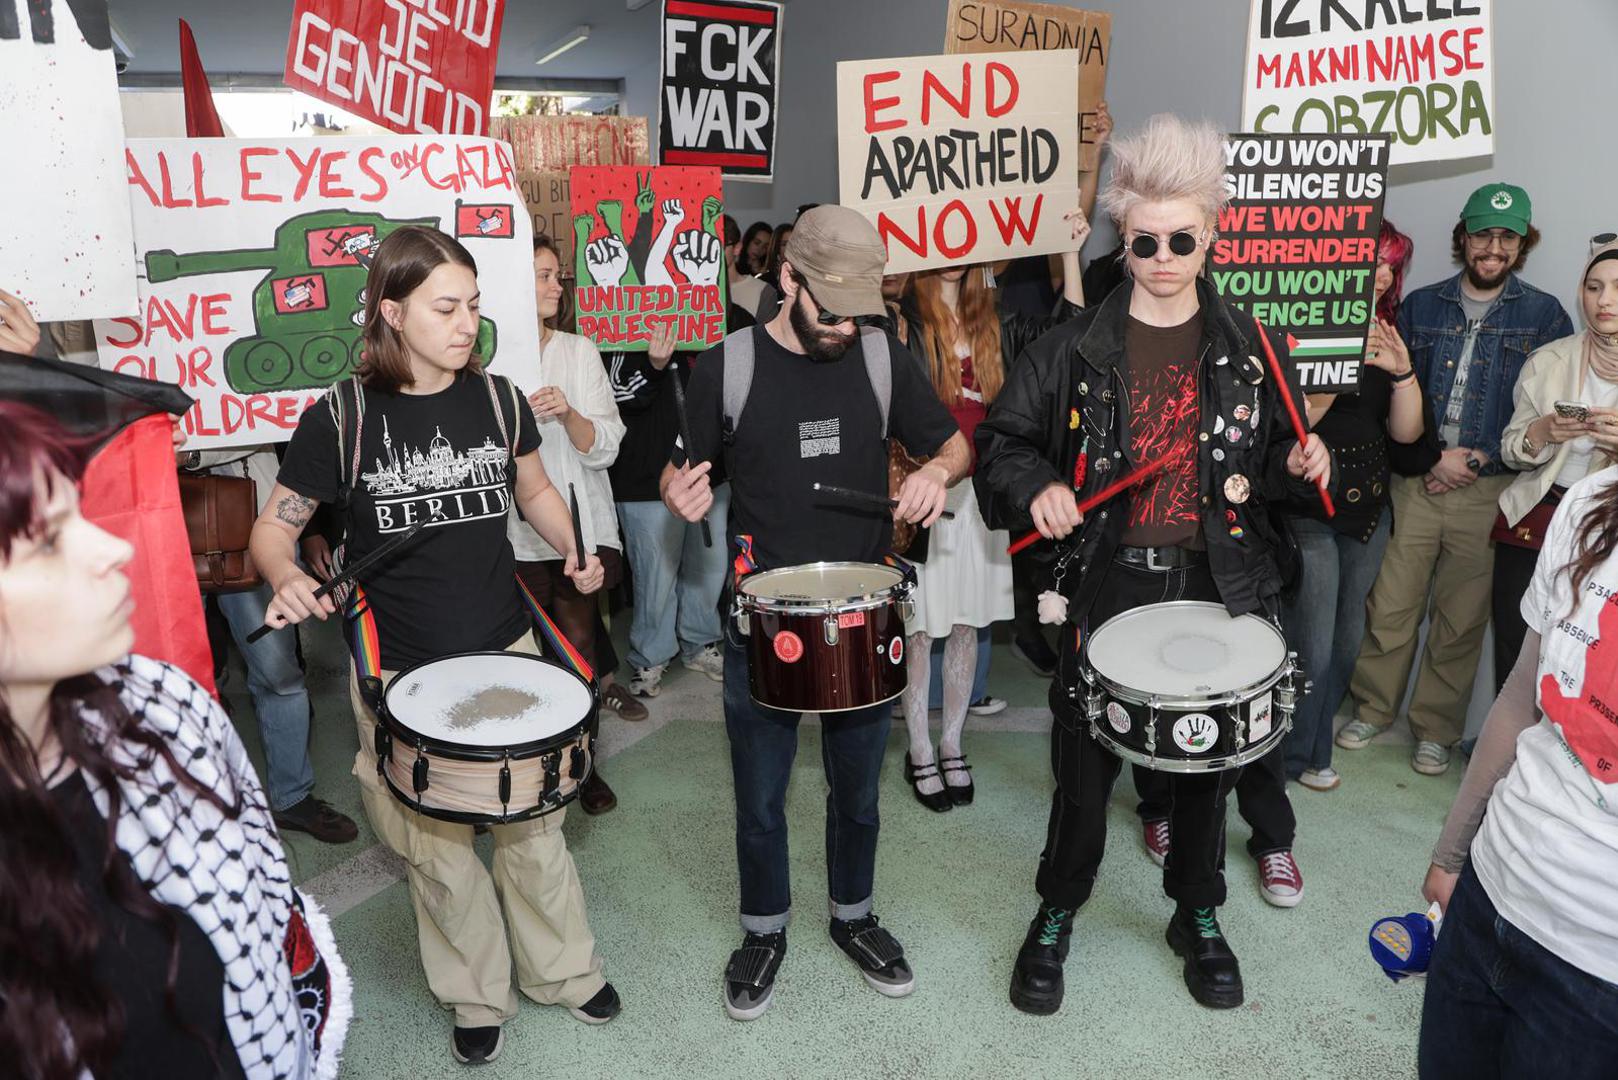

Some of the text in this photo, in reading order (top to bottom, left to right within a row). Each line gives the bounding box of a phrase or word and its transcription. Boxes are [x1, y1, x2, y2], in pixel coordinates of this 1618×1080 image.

[378, 0, 438, 74] JE
[666, 18, 772, 85] FCK
[1256, 27, 1485, 89] MAKNI NAM SE
[294, 11, 482, 136] GENOCID
[665, 85, 770, 151] WAR
[863, 62, 1020, 134] END
[1292, 80, 1492, 146] OBZORA
[860, 125, 1060, 200] APARTHEID
[1223, 139, 1386, 167] YOU WON'T
[126, 148, 230, 208] ALL
[240, 146, 389, 202] EYES
[419, 142, 516, 192] GAZA
[1224, 172, 1384, 200] SILENCE US
[877, 193, 1044, 263] NOW
[1218, 205, 1373, 232] WE WON'T
[1212, 237, 1376, 265] SURRENDER
[577, 283, 725, 314] UNITED FOR
[1212, 269, 1371, 297] YOU WON'T
[106, 293, 237, 349] SAVE
[577, 312, 725, 346] PALESTINE
[1331, 300, 1368, 326] US
[113, 346, 217, 388] OUR
[375, 487, 510, 530] BERLIN
[1561, 670, 1575, 689] THE
[1596, 758, 1613, 773] OF
